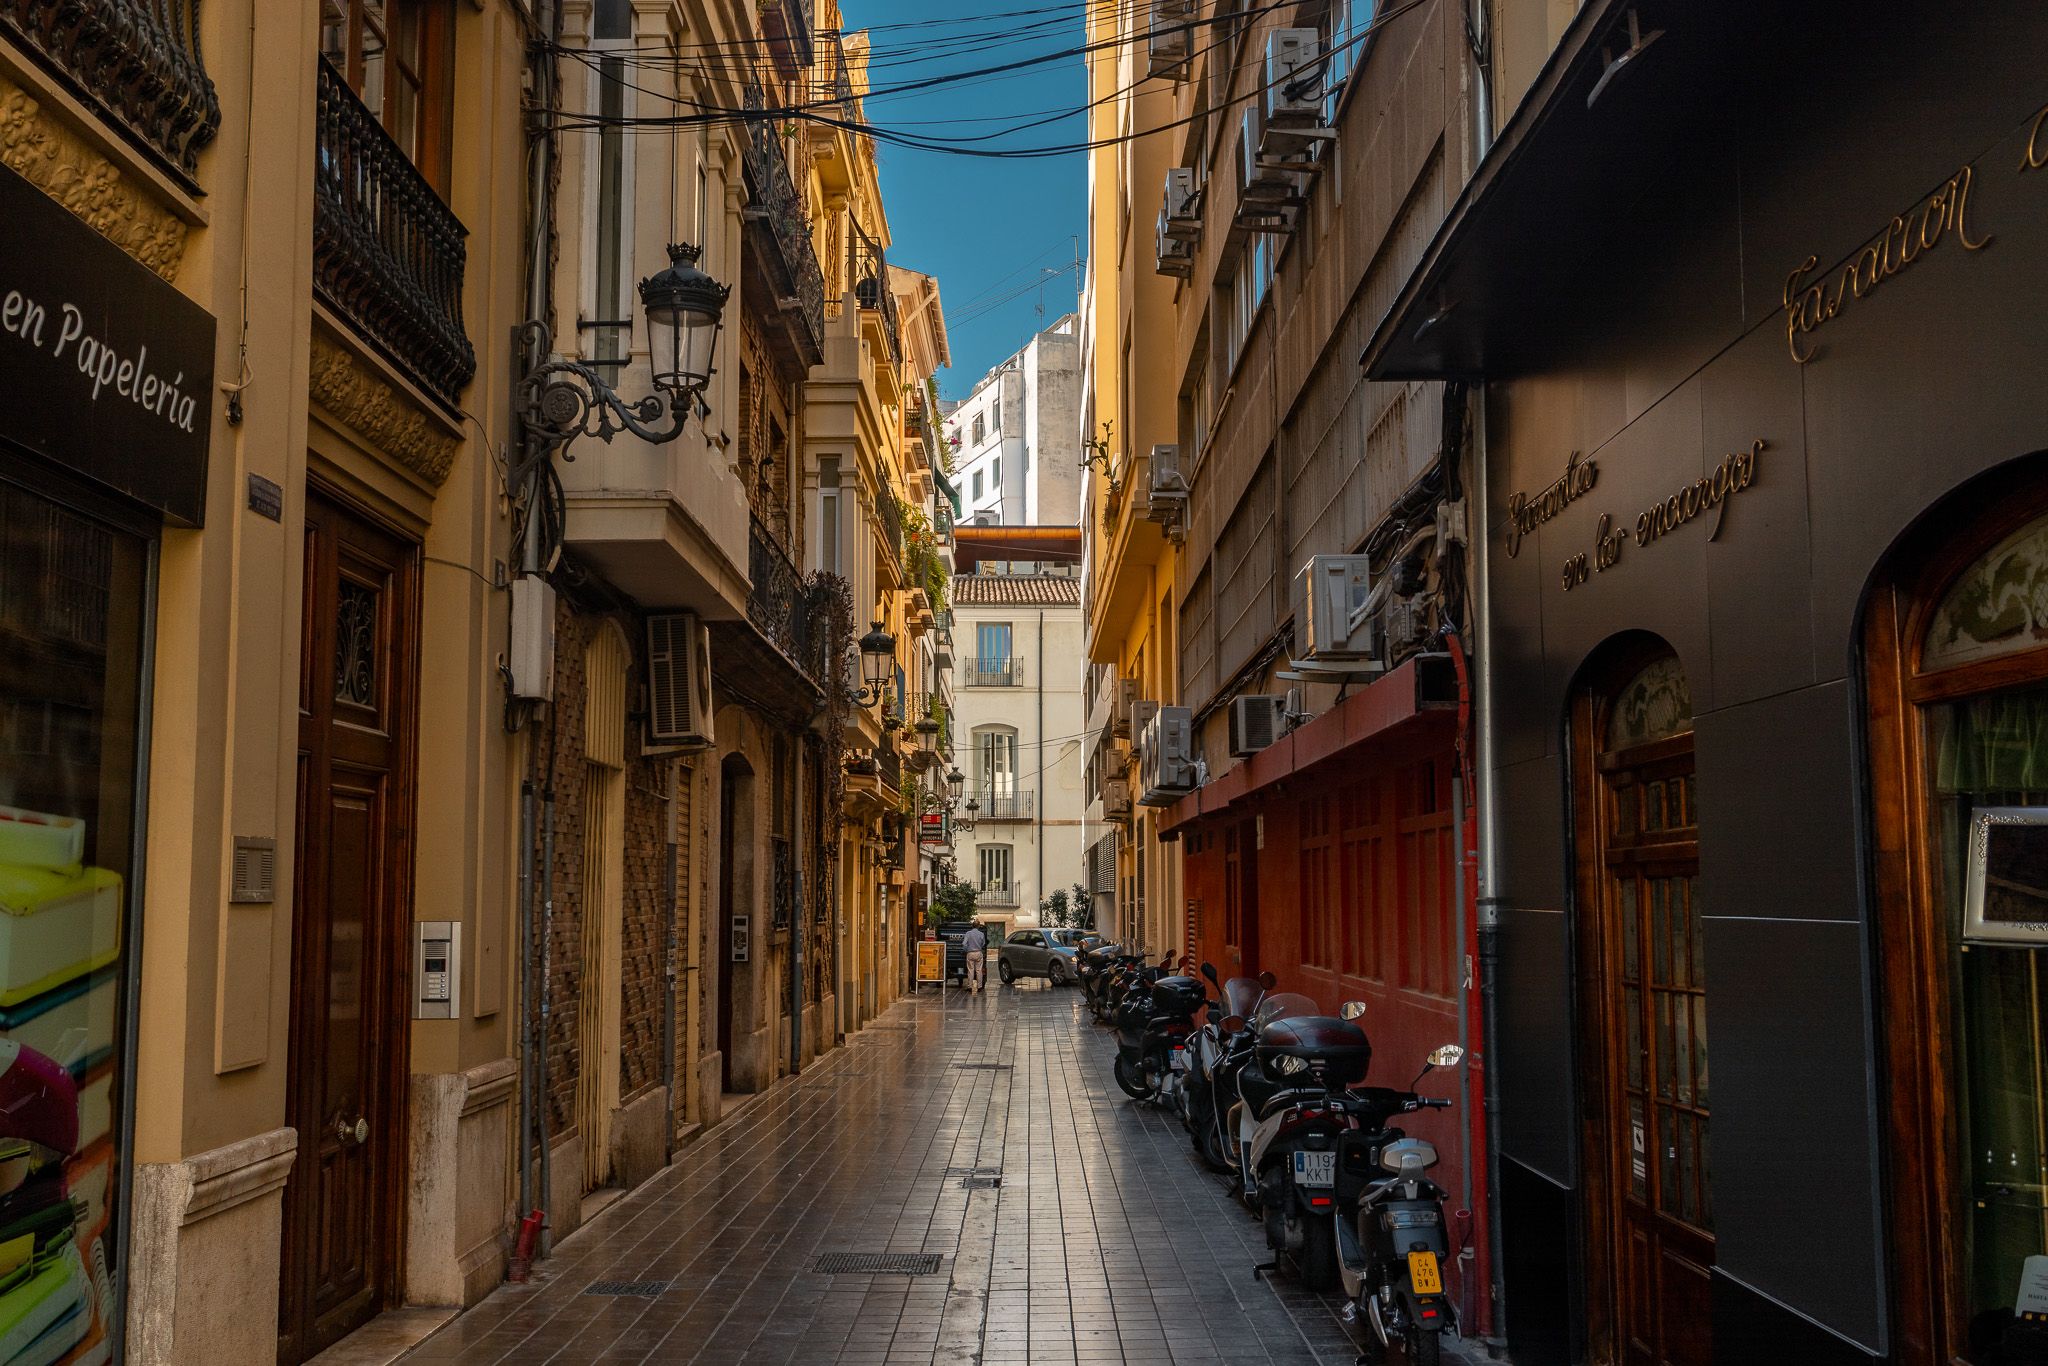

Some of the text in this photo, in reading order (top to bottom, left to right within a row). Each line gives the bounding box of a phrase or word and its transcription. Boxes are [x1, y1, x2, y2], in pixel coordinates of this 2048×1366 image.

[2, 290, 197, 433] en Papelería
[1562, 439, 1766, 591] en los encargos
[1306, 1168, 1331, 1182] KKT
[1416, 1268, 1434, 1277] 476
